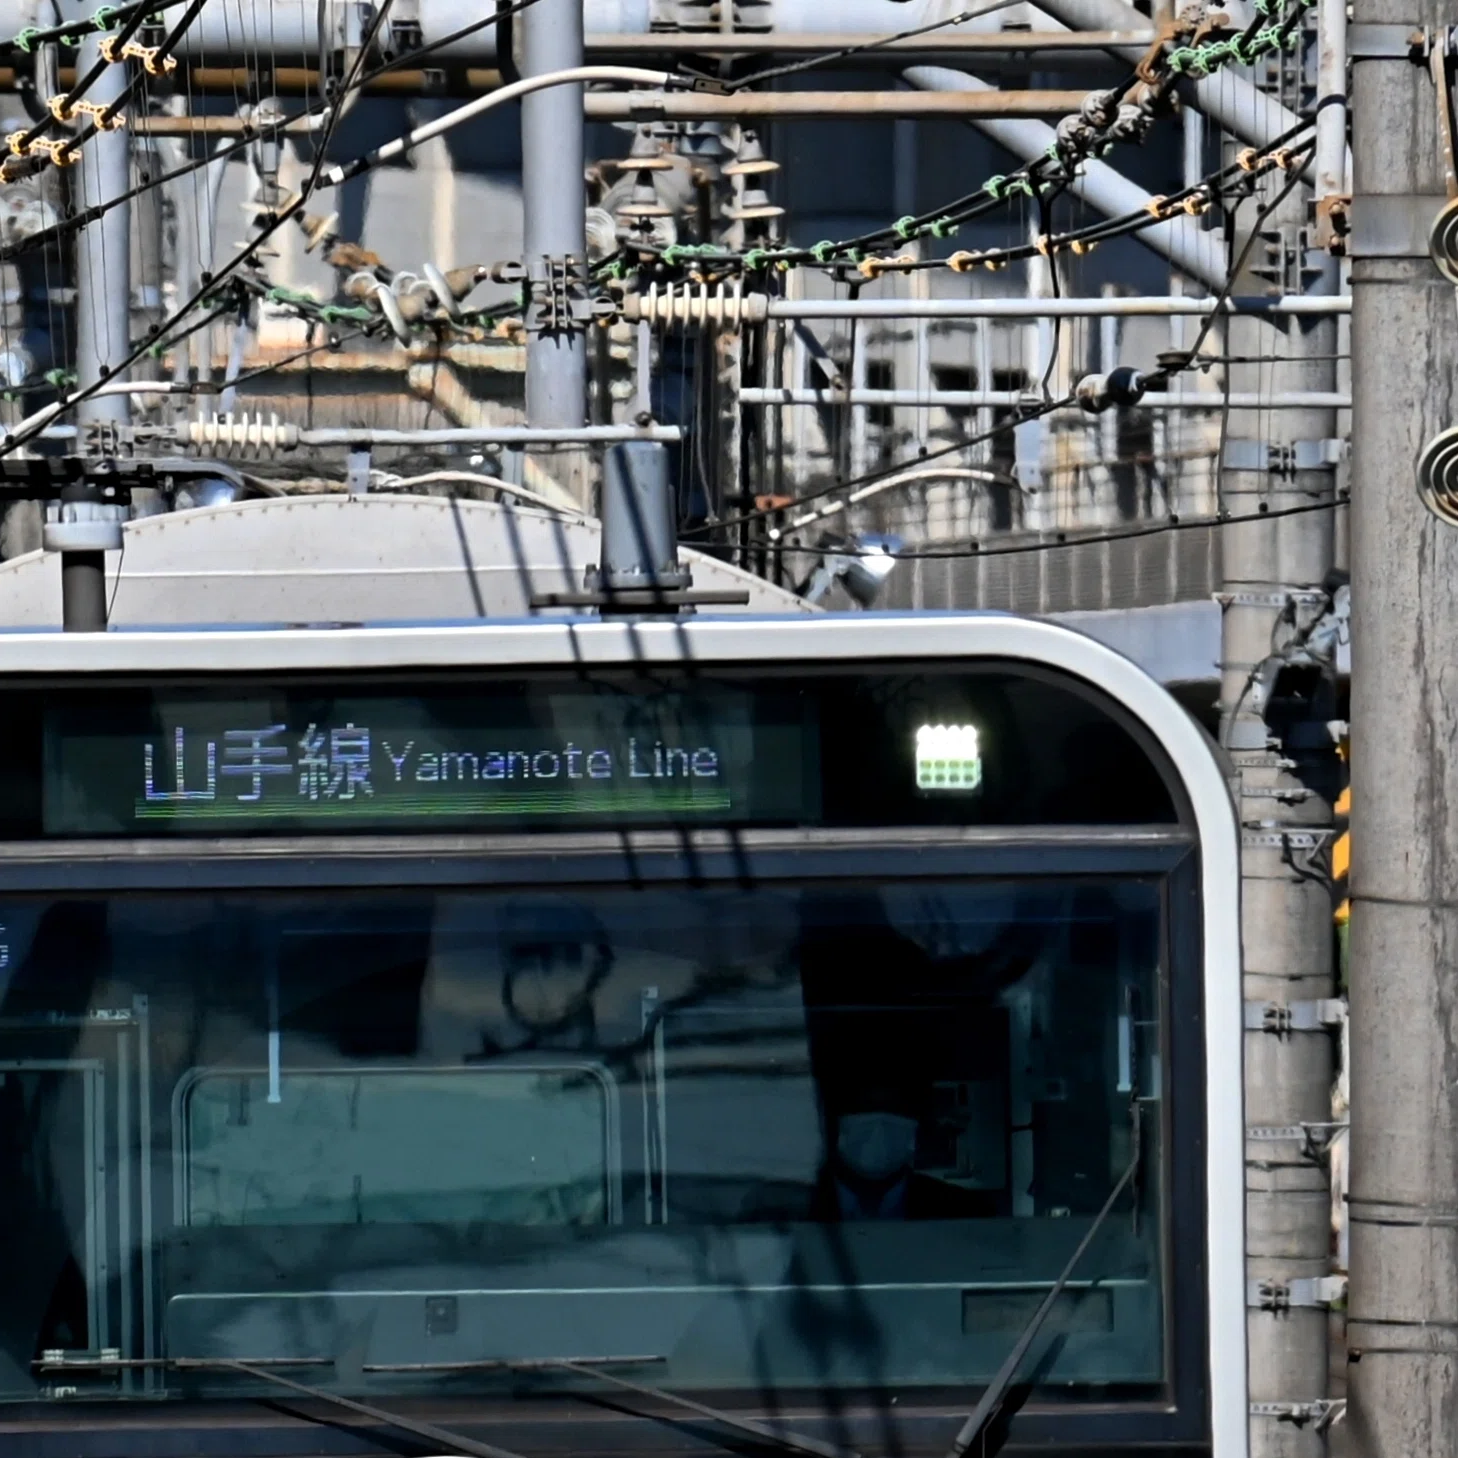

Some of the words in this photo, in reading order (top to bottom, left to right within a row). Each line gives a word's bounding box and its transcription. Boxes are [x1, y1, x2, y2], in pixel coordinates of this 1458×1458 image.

[145, 723, 374, 801] 山手線
[382, 741, 612, 781] Yamanote
[629, 738, 719, 777] Line
